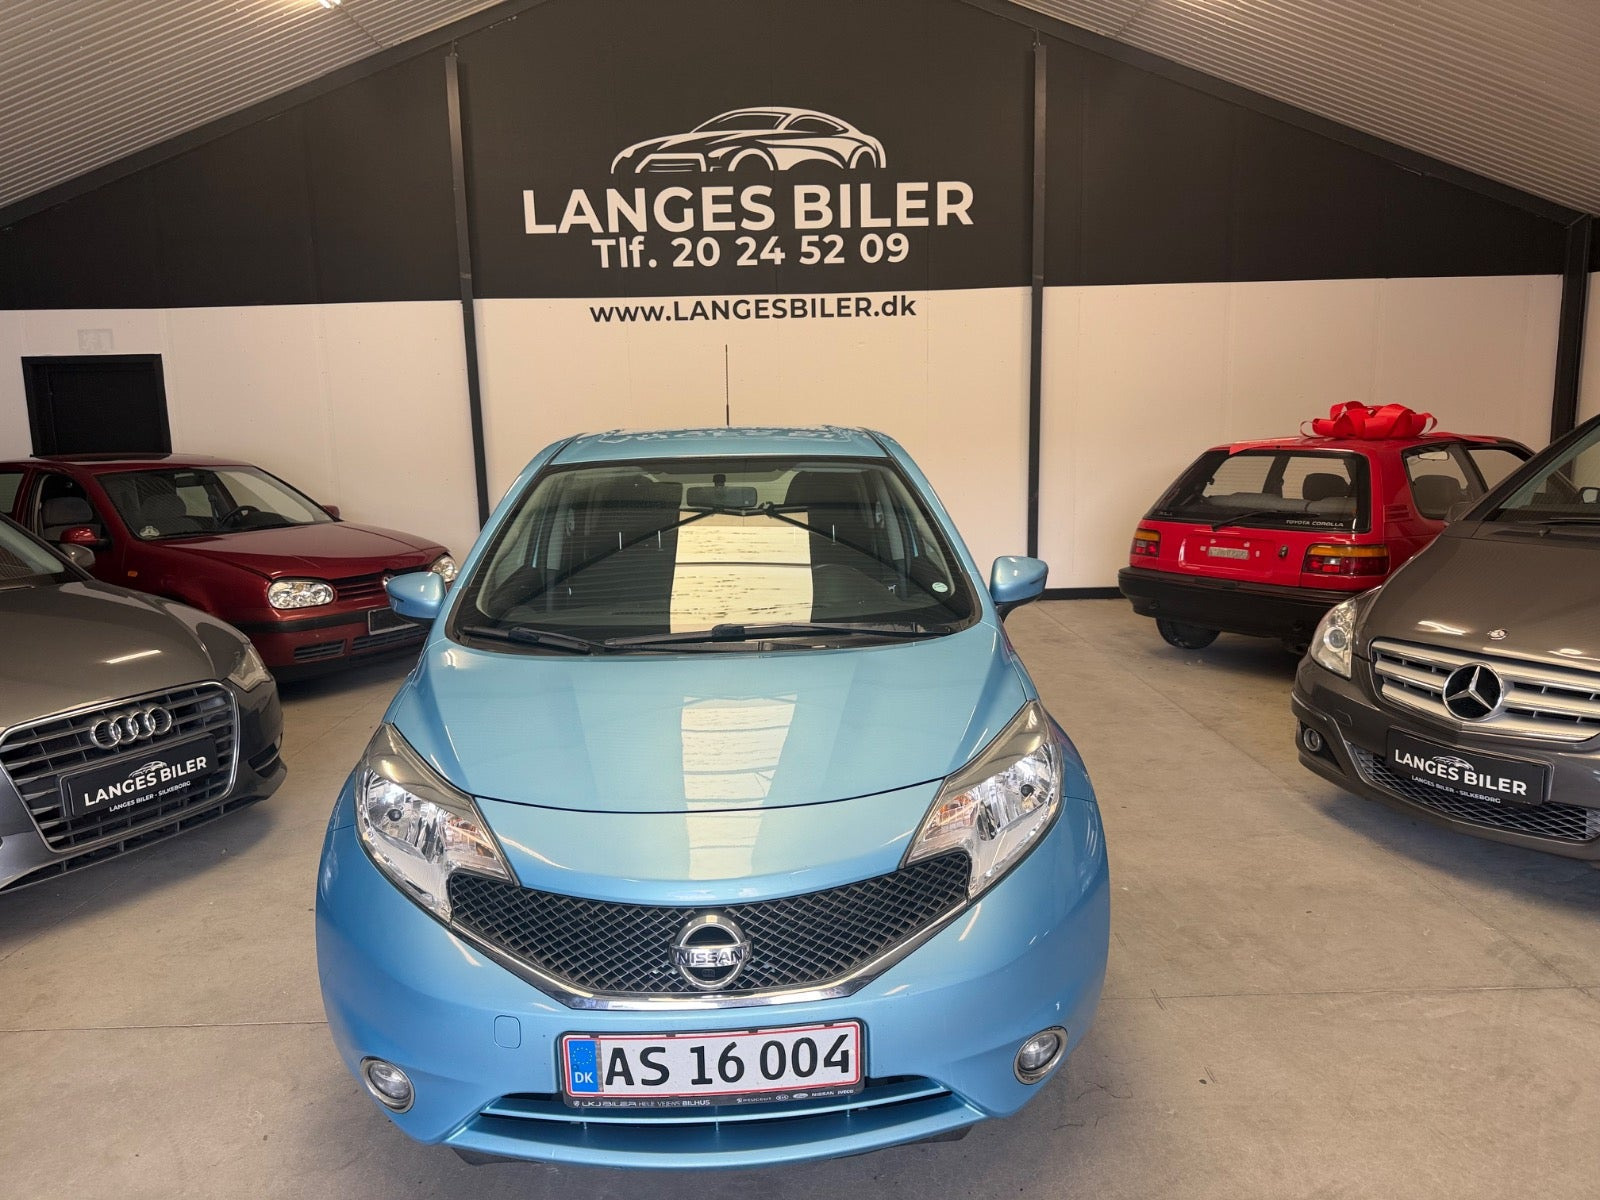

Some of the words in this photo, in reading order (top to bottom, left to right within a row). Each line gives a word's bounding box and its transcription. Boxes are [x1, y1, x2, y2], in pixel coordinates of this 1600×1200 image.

[522, 185, 775, 234] LANGES
[793, 181, 974, 229] BILER
[592, 236, 657, 268] Tlf.
[672, 237, 720, 267] 20
[736, 236, 785, 266] 24
[799, 234, 845, 264] 52
[860, 233, 910, 263] 09
[590, 295, 917, 323] www.LANGESBILER.dk
[83, 772, 157, 807] LANGES
[160, 756, 207, 782] BILER
[1395, 749, 1460, 781] LANGES
[1464, 770, 1527, 796] BILER
[109, 798, 136, 812] LANGES
[136, 793, 154, 804] BILER
[158, 781, 191, 796] SILKEBORG
[1411, 775, 1435, 787] LANGES
[1435, 783, 1455, 794] BILER
[1459, 790, 1501, 804] SILKEBORG
[676, 948, 743, 966] NISSAN
[605, 1046, 671, 1086] AS
[690, 1041, 745, 1086] 16
[759, 1034, 850, 1081] 004
[574, 1071, 594, 1084] DK
